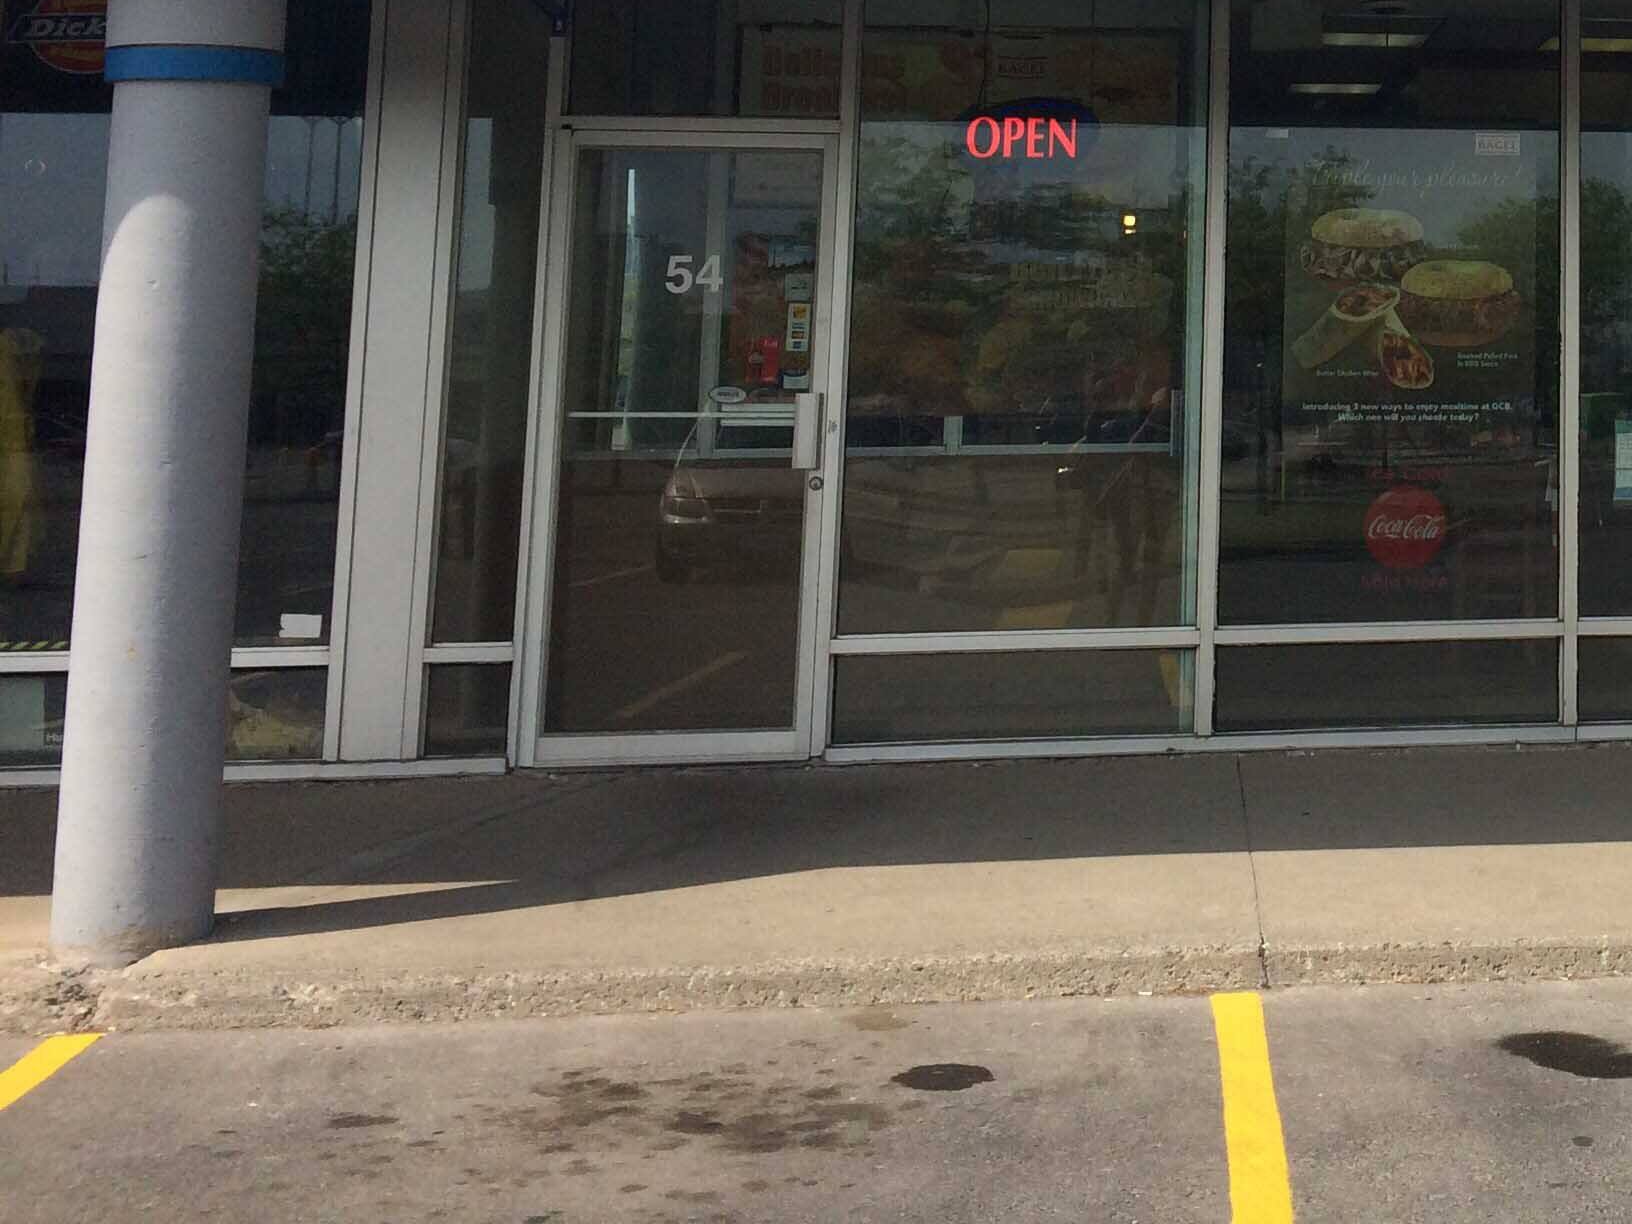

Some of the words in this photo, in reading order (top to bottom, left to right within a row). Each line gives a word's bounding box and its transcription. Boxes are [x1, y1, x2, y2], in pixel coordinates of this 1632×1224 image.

[24, 18, 107, 37] Dick
[965, 116, 1078, 159] OPEN
[664, 254, 725, 295] 54
